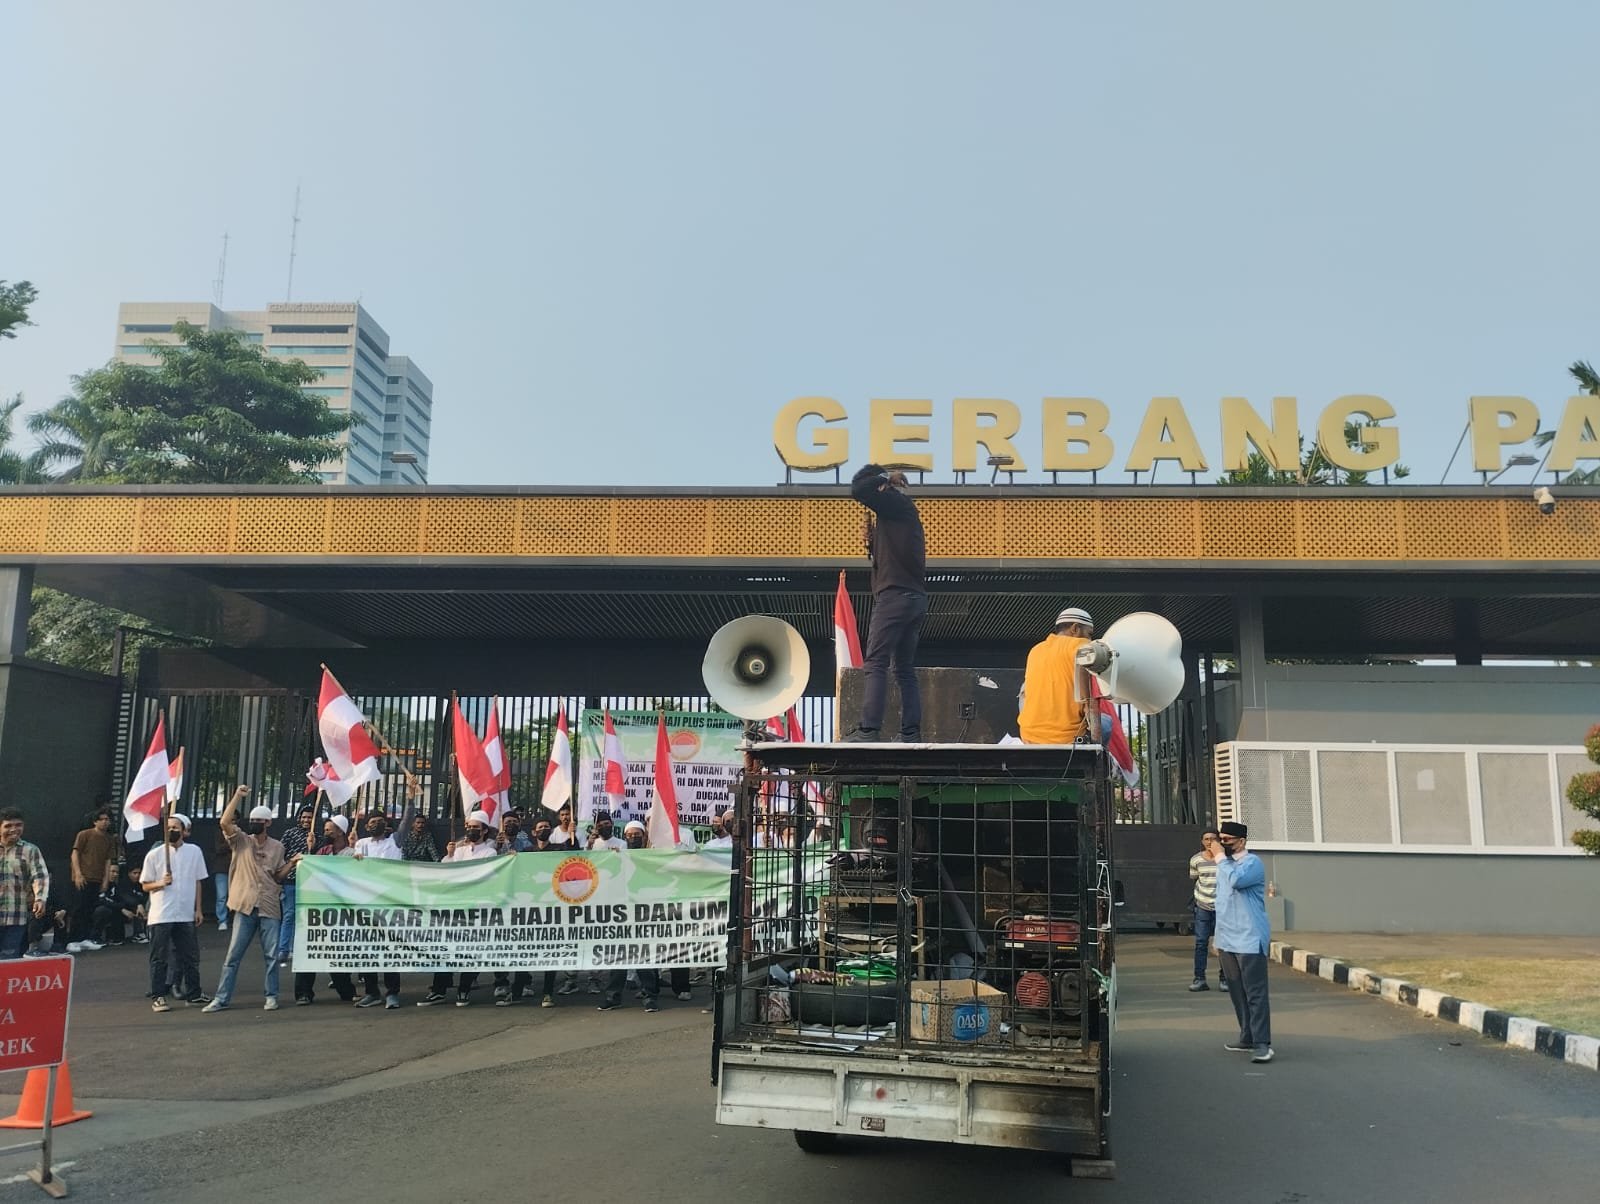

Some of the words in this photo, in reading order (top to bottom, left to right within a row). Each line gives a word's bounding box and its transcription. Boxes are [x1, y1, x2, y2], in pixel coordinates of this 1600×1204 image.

[773, 394, 1399, 473] GERBANG
[682, 717, 704, 727] PLUS
[706, 718, 725, 729] DAN
[692, 765, 723, 776] NURANI
[677, 777, 685, 786] RI
[687, 778, 704, 787] DAN
[696, 791, 729, 801] DUGAAN
[690, 803, 707, 812] DAN
[307, 908, 423, 927] BONGKAR
[429, 908, 504, 927] MAFIA
[511, 906, 561, 925] HAJI
[568, 904, 628, 924] PLUS
[634, 902, 683, 922] DAN
[307, 929, 328, 942] DPP
[330, 929, 385, 942] GERAKAN
[445, 929, 491, 942] NURANI
[494, 927, 565, 942] NUSANTARA
[568, 924, 632, 940] MENDESAK
[635, 923, 673, 938] KETUA
[675, 922, 700, 937] DPR
[306, 944, 390, 952] MEMBENTUK
[394, 944, 449, 952] PANSUS
[455, 944, 514, 952] DUGAAN
[517, 943, 579, 951] KORUPSI
[543, 951, 578, 959] 2024
[592, 943, 651, 966] SUARA
[6, 973, 65, 994] PADA
[956, 1014, 986, 1030] OASIS
